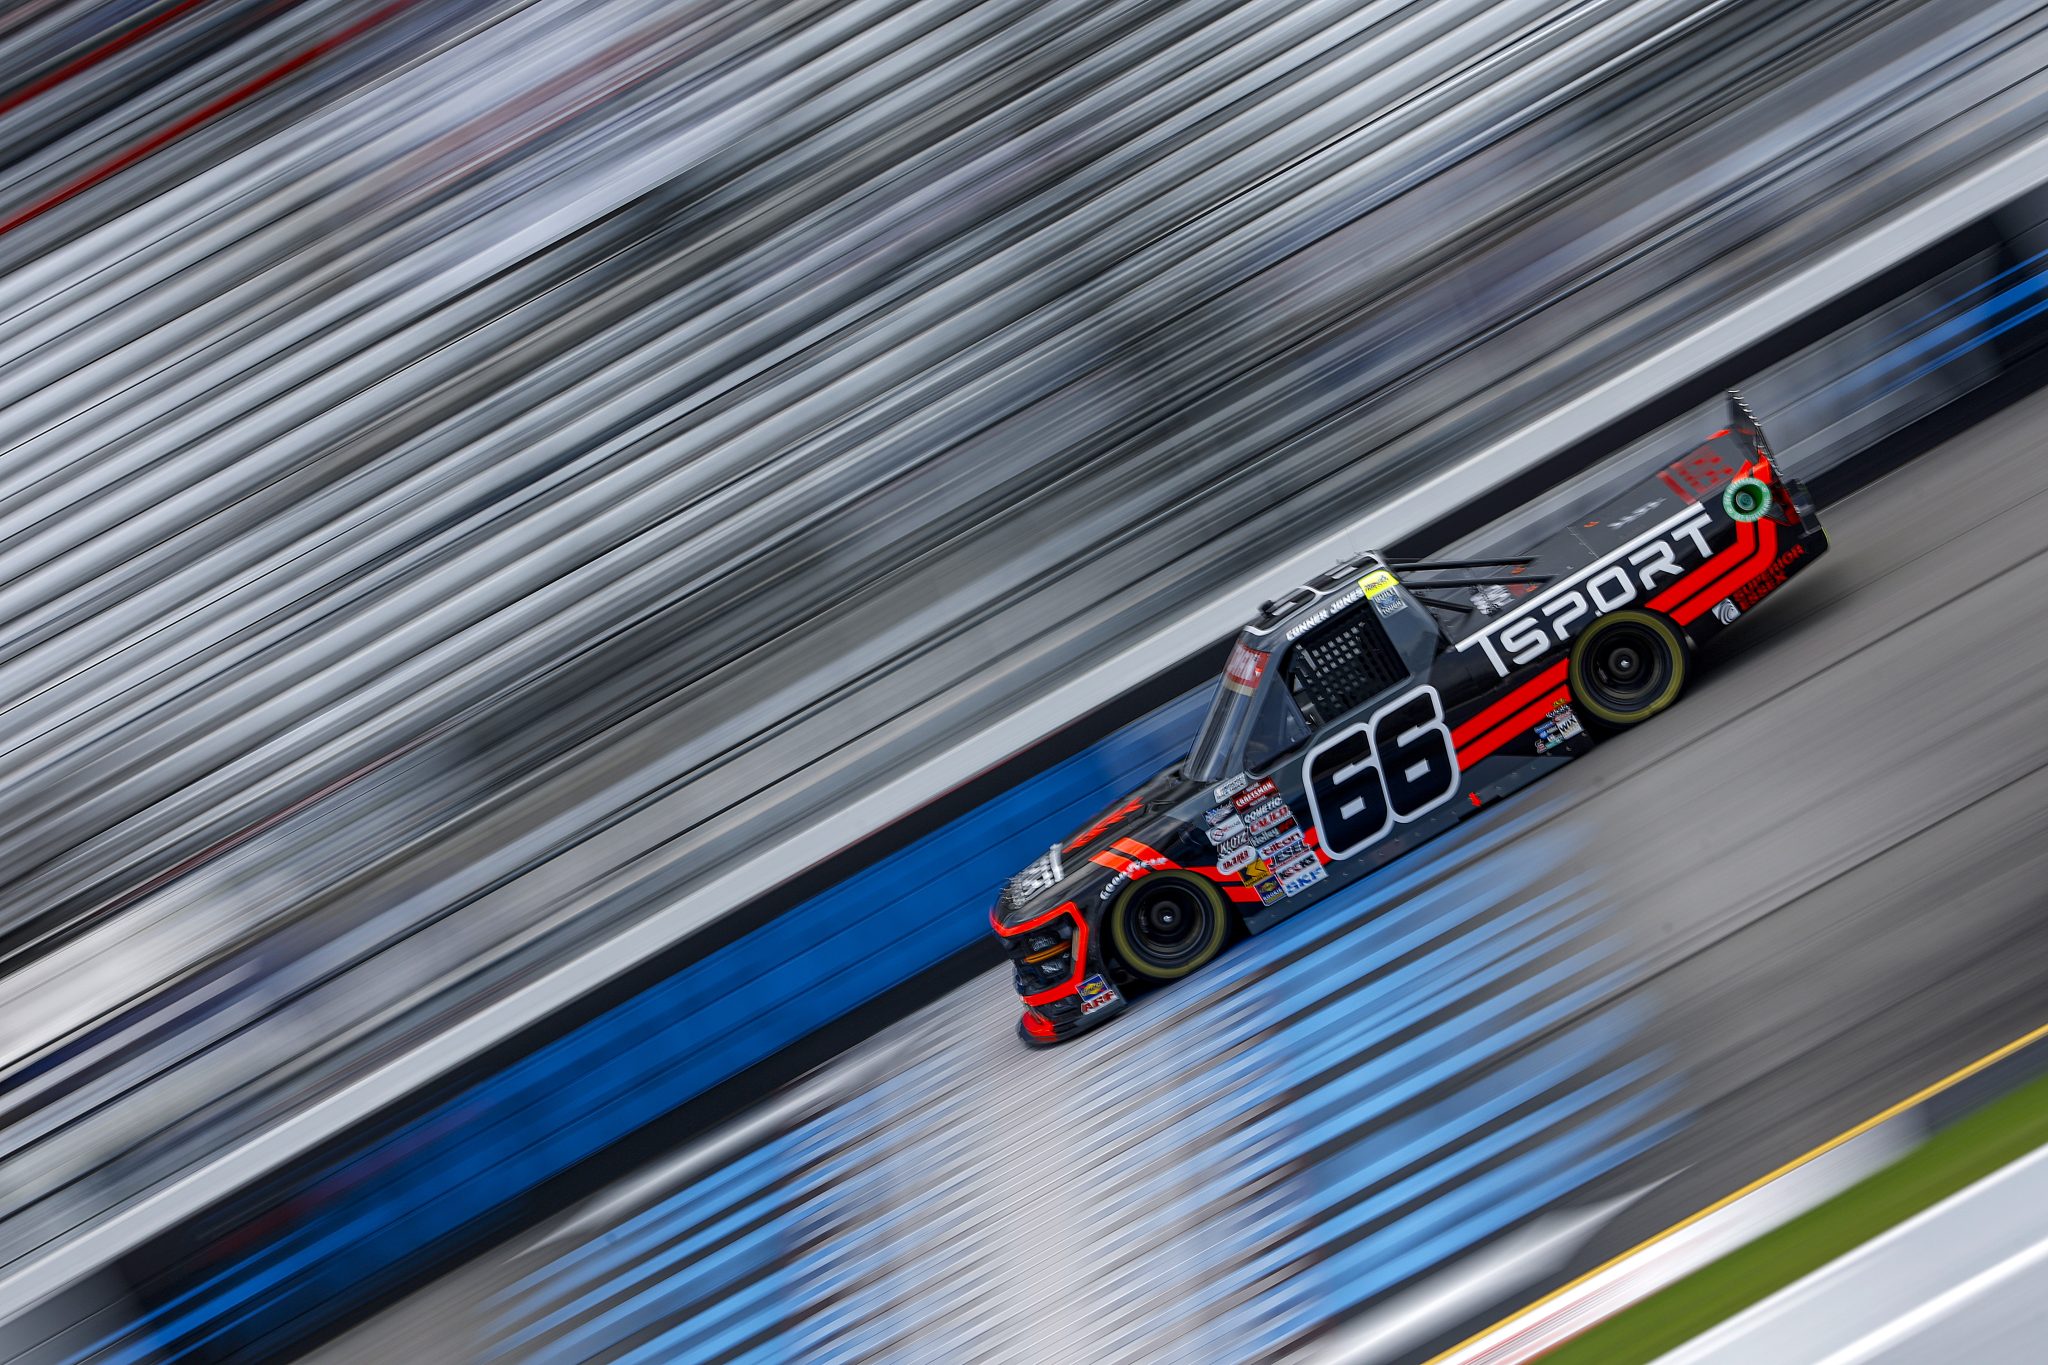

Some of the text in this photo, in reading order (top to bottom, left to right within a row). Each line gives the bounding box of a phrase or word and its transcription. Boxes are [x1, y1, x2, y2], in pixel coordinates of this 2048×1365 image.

[1286, 587, 1365, 641] CONNER JONES
[1559, 716, 1577, 732] WIX
[1302, 685, 1460, 862] 66
[1236, 781, 1275, 807] CRAFTSMAN
[1244, 794, 1283, 824] COMETIC
[1217, 829, 1249, 856] KLOTZ
[1251, 827, 1280, 848] Holley
[1268, 838, 1311, 870] JESEL
[1285, 867, 1322, 894] SKF
